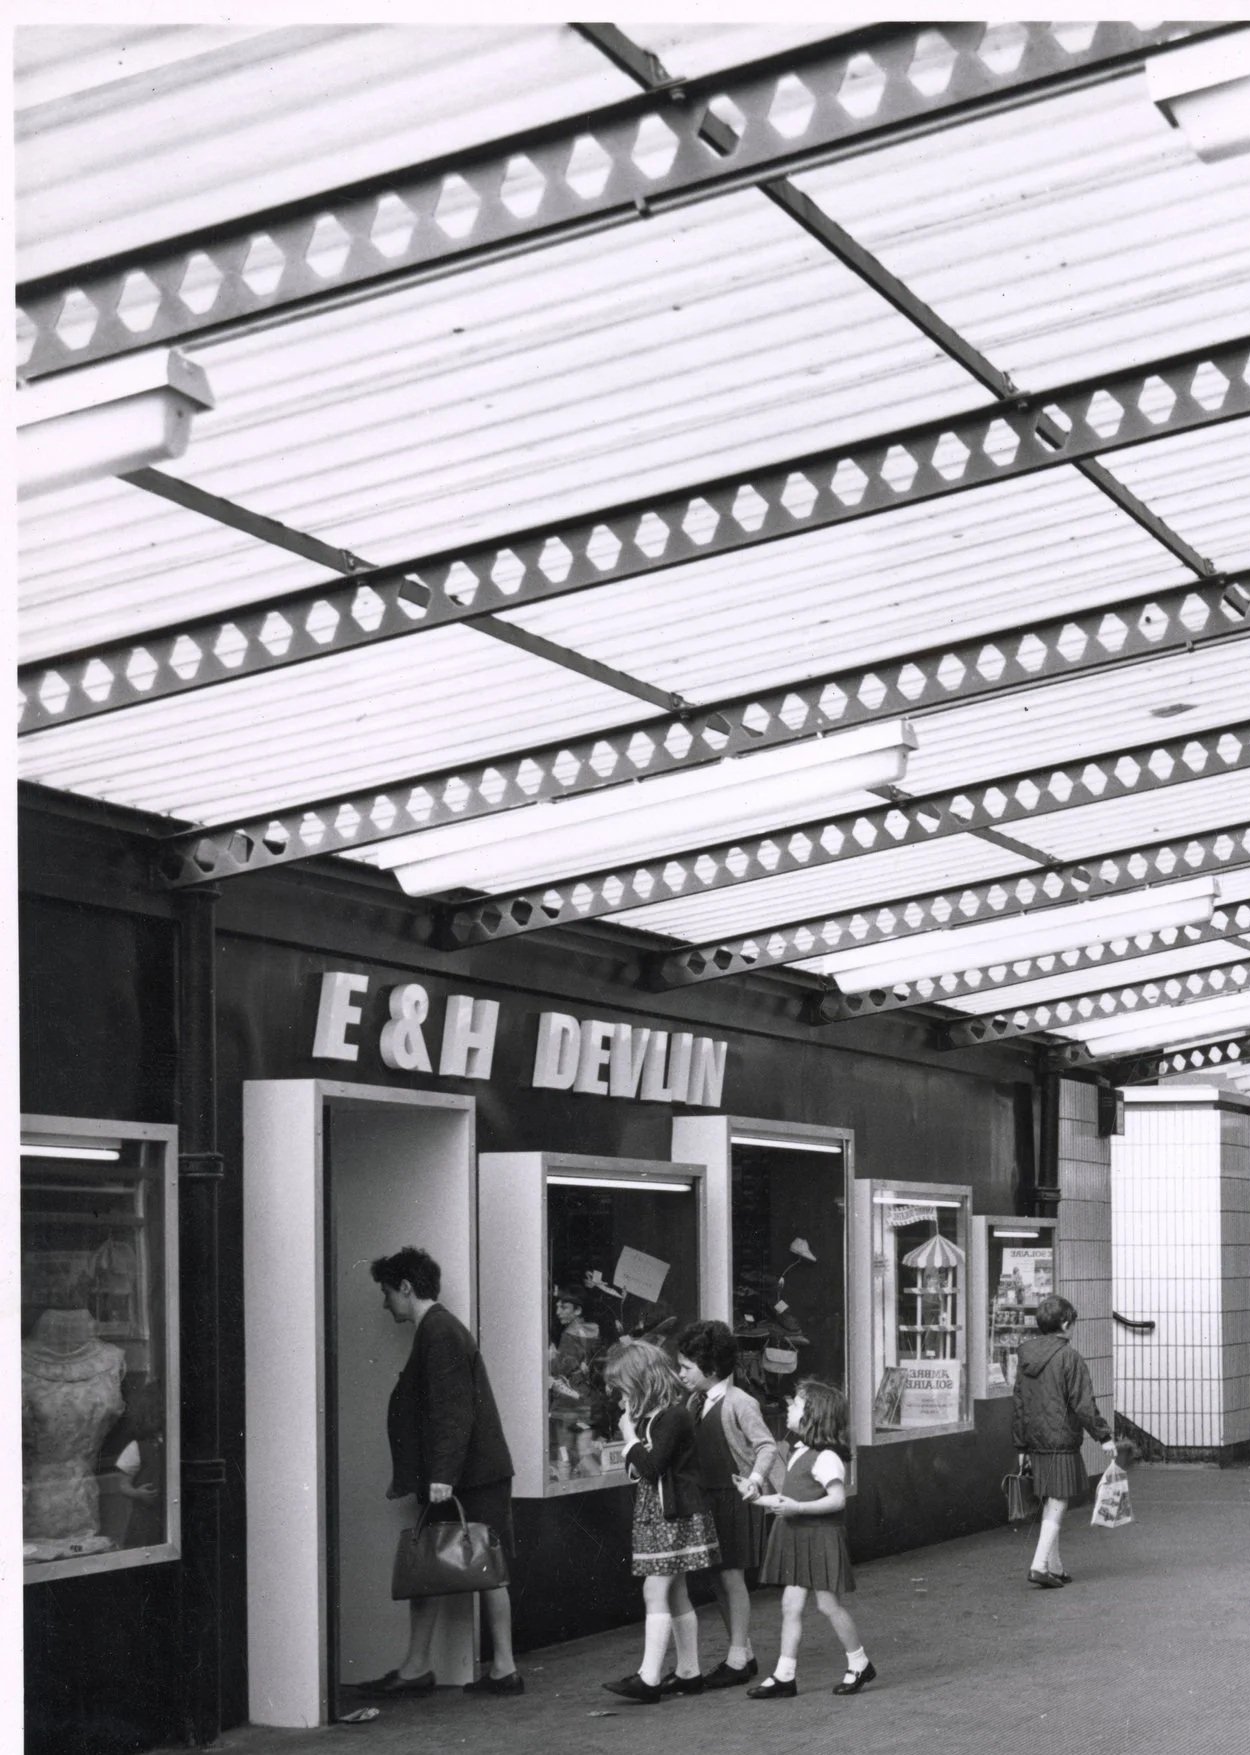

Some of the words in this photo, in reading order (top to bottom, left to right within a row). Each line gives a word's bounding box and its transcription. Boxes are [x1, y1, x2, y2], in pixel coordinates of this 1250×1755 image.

[313, 972, 369, 1061] E
[380, 984, 432, 1073] &
[439, 995, 499, 1080] H
[532, 1012, 728, 1107] DEVLIN
